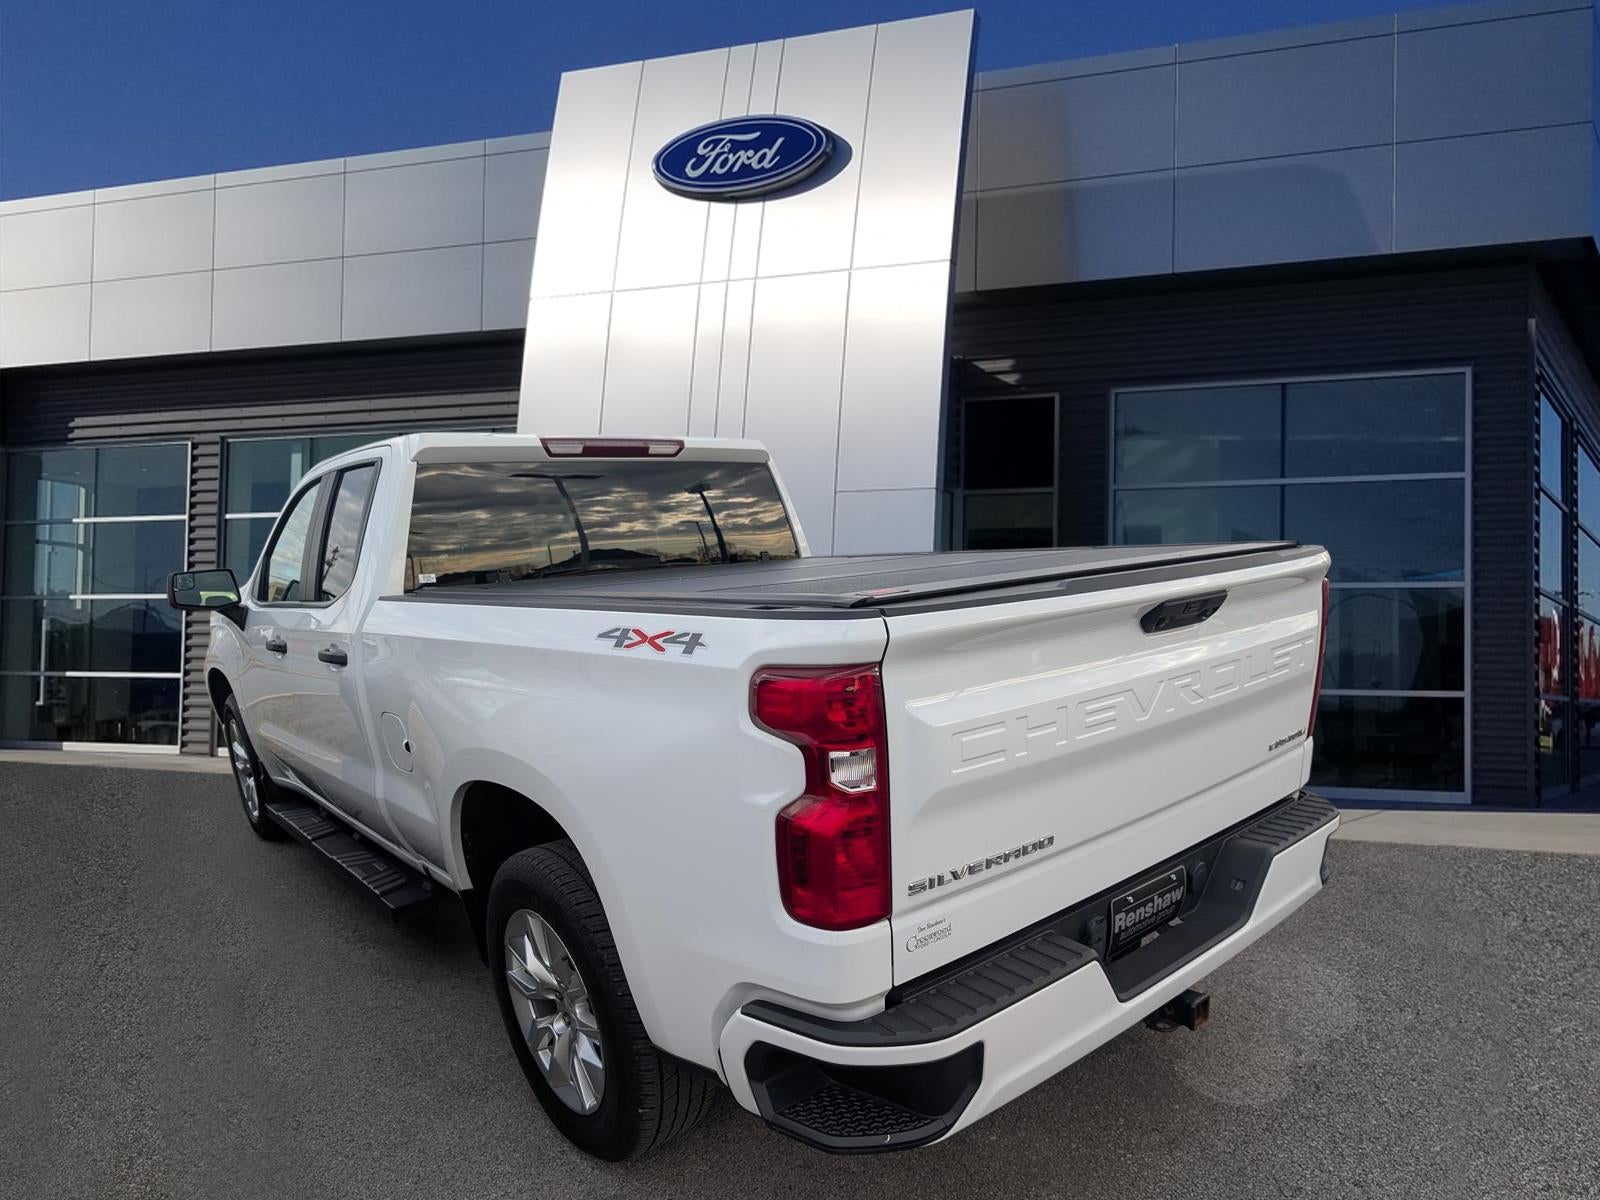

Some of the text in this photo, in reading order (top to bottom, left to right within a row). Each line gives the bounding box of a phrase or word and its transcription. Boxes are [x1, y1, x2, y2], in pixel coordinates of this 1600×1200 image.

[685, 131, 785, 178] Ford
[952, 637, 1314, 774] CHEVROLET
[908, 835, 1054, 896] SILVERADO
[1114, 886, 1184, 934] Renshaw
